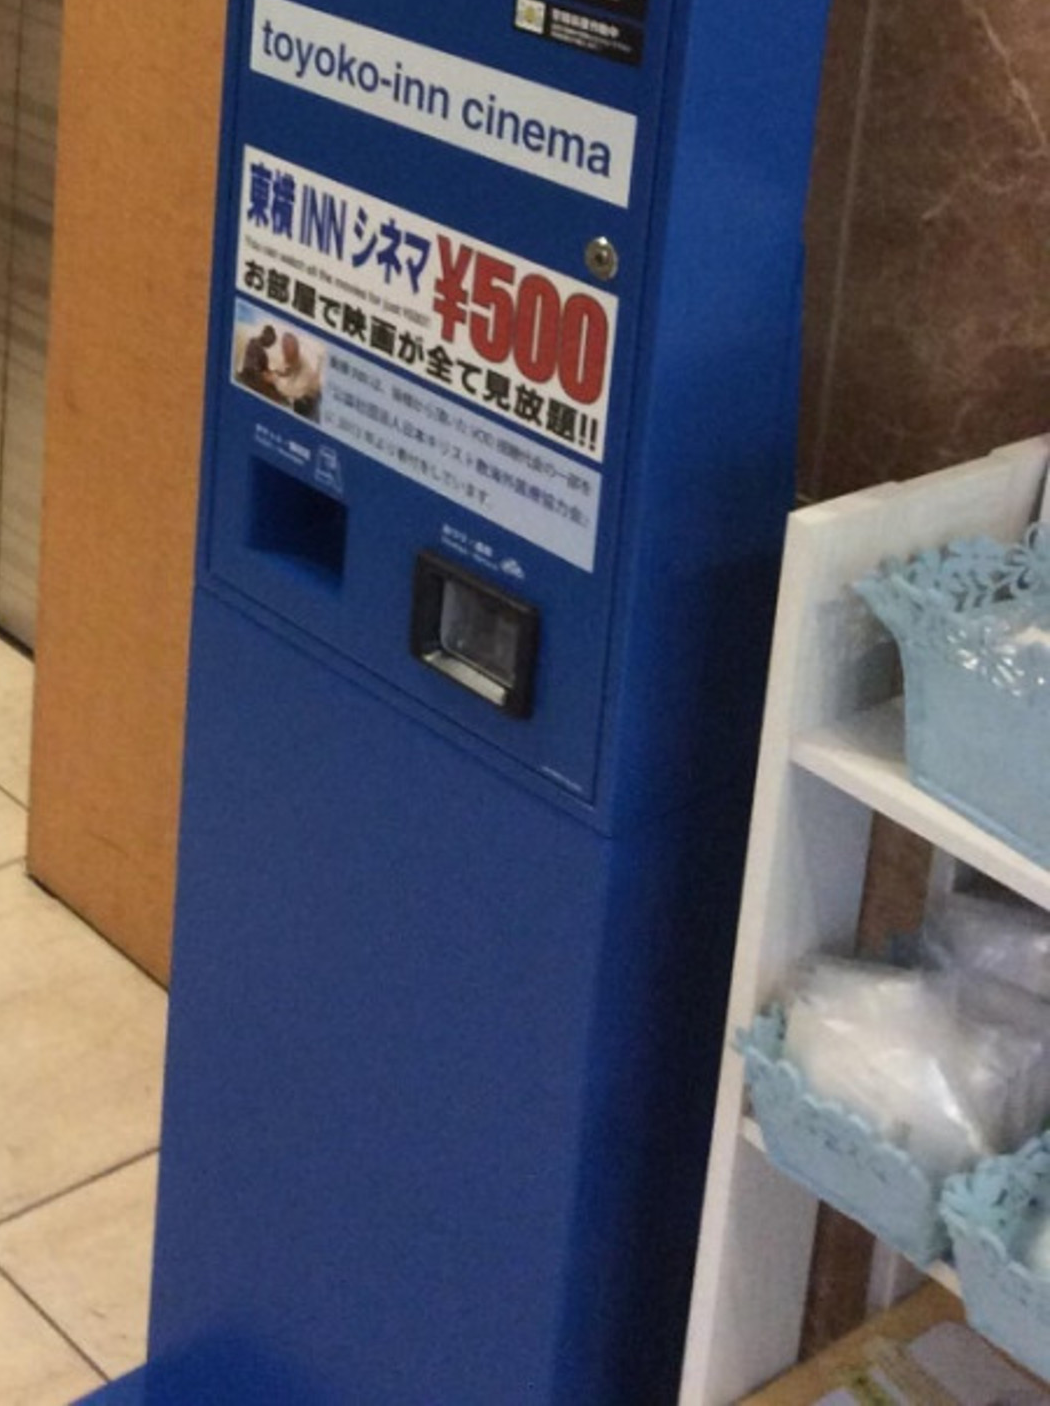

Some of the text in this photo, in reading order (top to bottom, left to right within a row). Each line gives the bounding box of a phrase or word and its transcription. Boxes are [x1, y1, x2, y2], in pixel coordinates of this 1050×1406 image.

[262, 20, 612, 178] toyoko-inn cinema
[244, 259, 598, 452] お部屋で映画が全て見放題!!
[433, 233, 609, 406] ¥500
